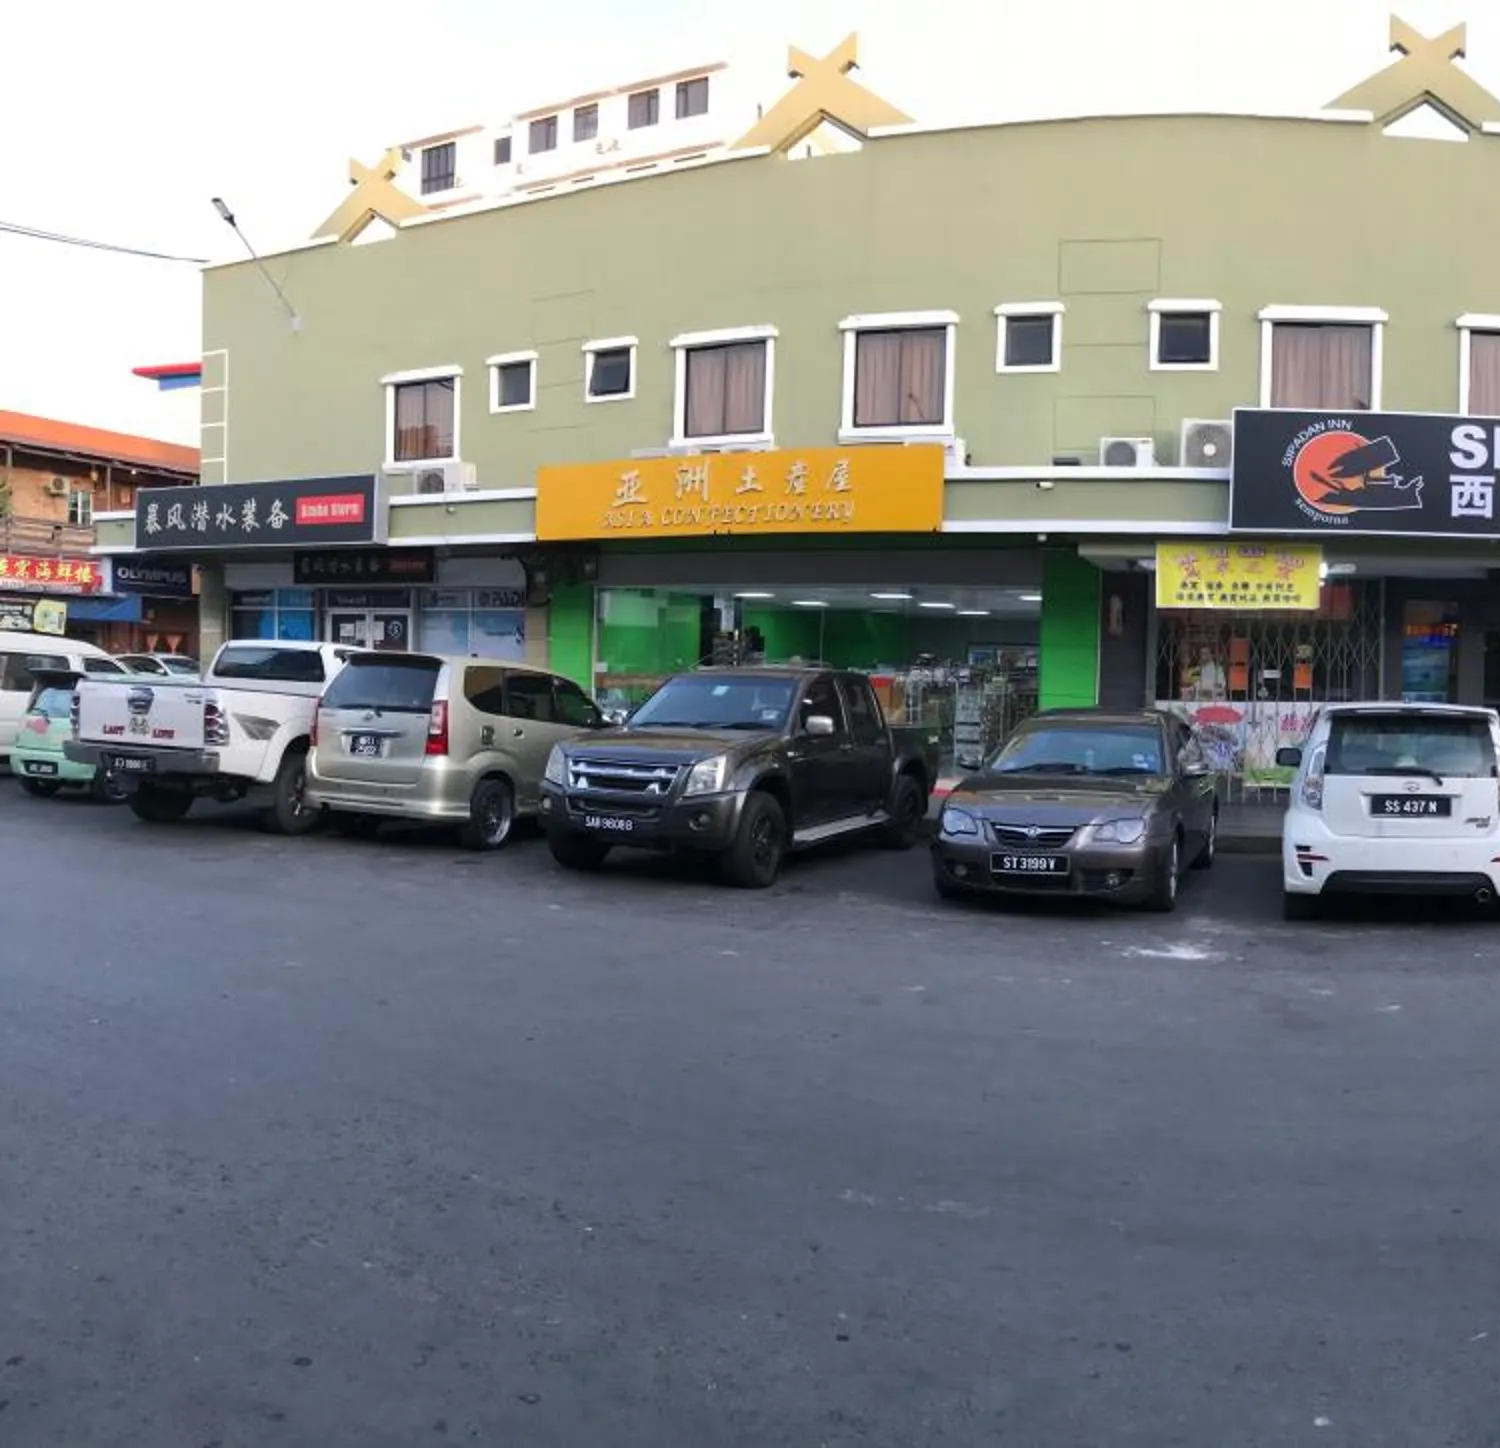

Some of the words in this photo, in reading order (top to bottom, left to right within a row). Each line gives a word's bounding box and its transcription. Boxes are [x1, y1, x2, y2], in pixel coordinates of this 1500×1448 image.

[1282, 420, 1326, 468] SIPADAN
[1327, 418, 1353, 431] INN
[612, 458, 855, 507] 亚洲土产屋
[144, 497, 289, 534] 暴风潜水装备
[604, 510, 653, 529] ASIA
[117, 567, 187, 582] OLYMPUS
[1385, 800, 1400, 813] SS
[1403, 800, 1426, 813] 437
[1003, 856, 1017, 869] ST
[1020, 857, 1047, 870] 3199
